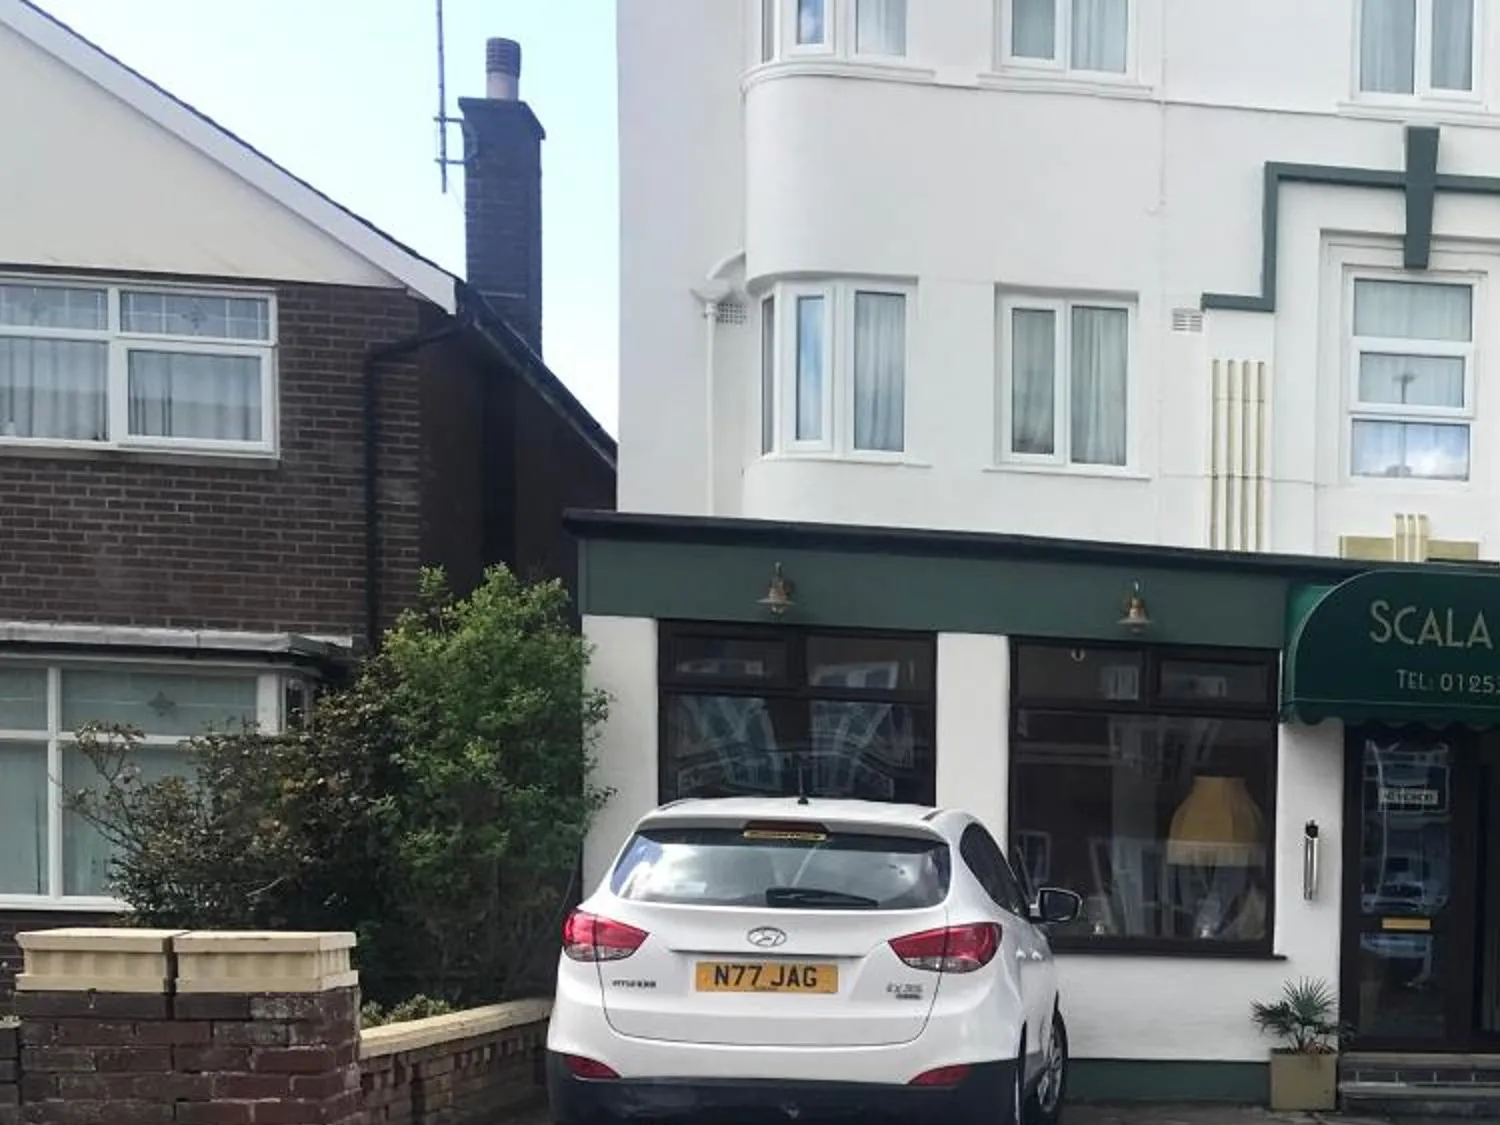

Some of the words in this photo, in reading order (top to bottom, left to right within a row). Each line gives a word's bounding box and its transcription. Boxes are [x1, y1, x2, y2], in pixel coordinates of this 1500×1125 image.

[1369, 600, 1494, 650] SCALA
[713, 964, 763, 987] N77
[770, 967, 817, 988] JAG
